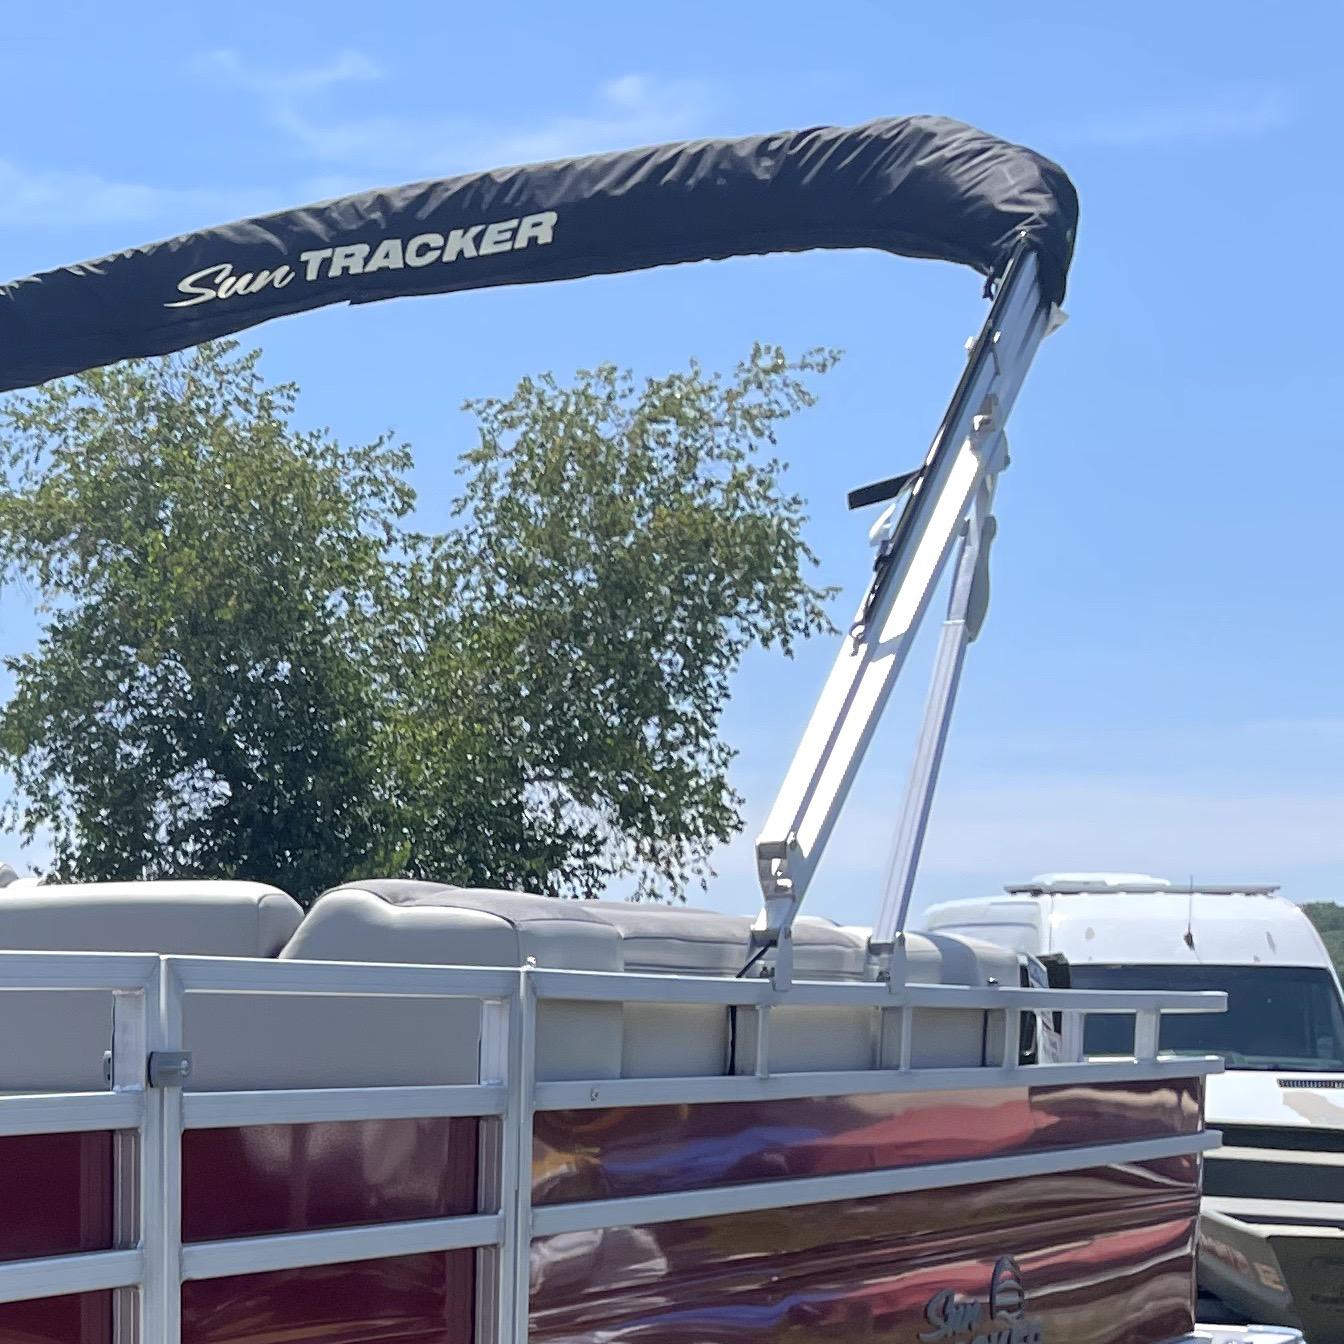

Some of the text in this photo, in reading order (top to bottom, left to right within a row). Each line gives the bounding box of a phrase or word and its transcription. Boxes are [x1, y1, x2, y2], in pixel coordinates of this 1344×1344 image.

[163, 210, 558, 308] Sun TRACKER
[916, 1288, 982, 1343] Sun
